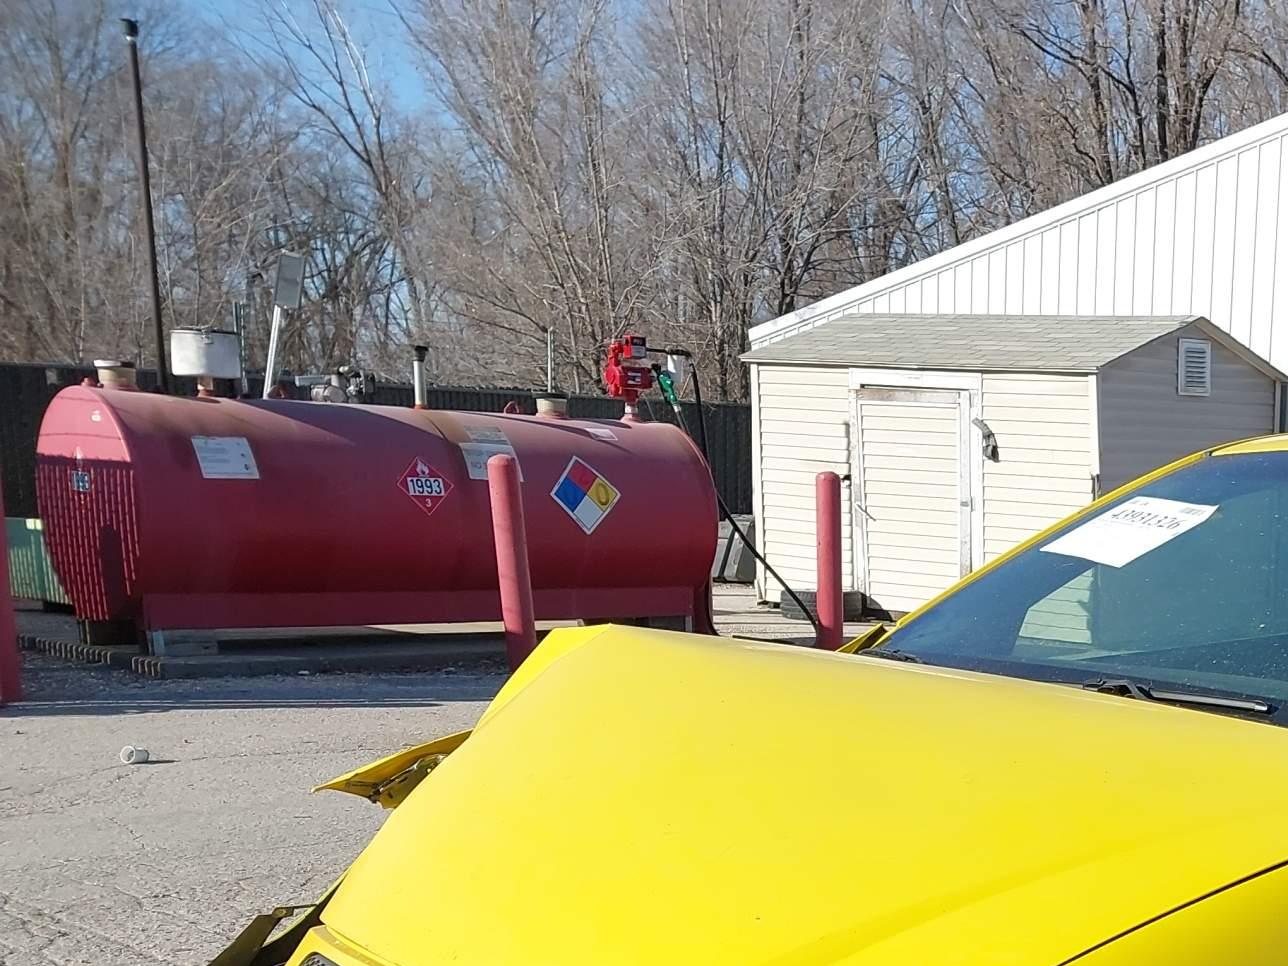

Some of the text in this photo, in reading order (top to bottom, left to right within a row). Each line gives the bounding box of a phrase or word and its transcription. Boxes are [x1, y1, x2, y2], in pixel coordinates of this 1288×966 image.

[409, 479, 442, 494] 1993
[425, 498, 432, 507] 3
[1111, 509, 1185, 530] 43931326
